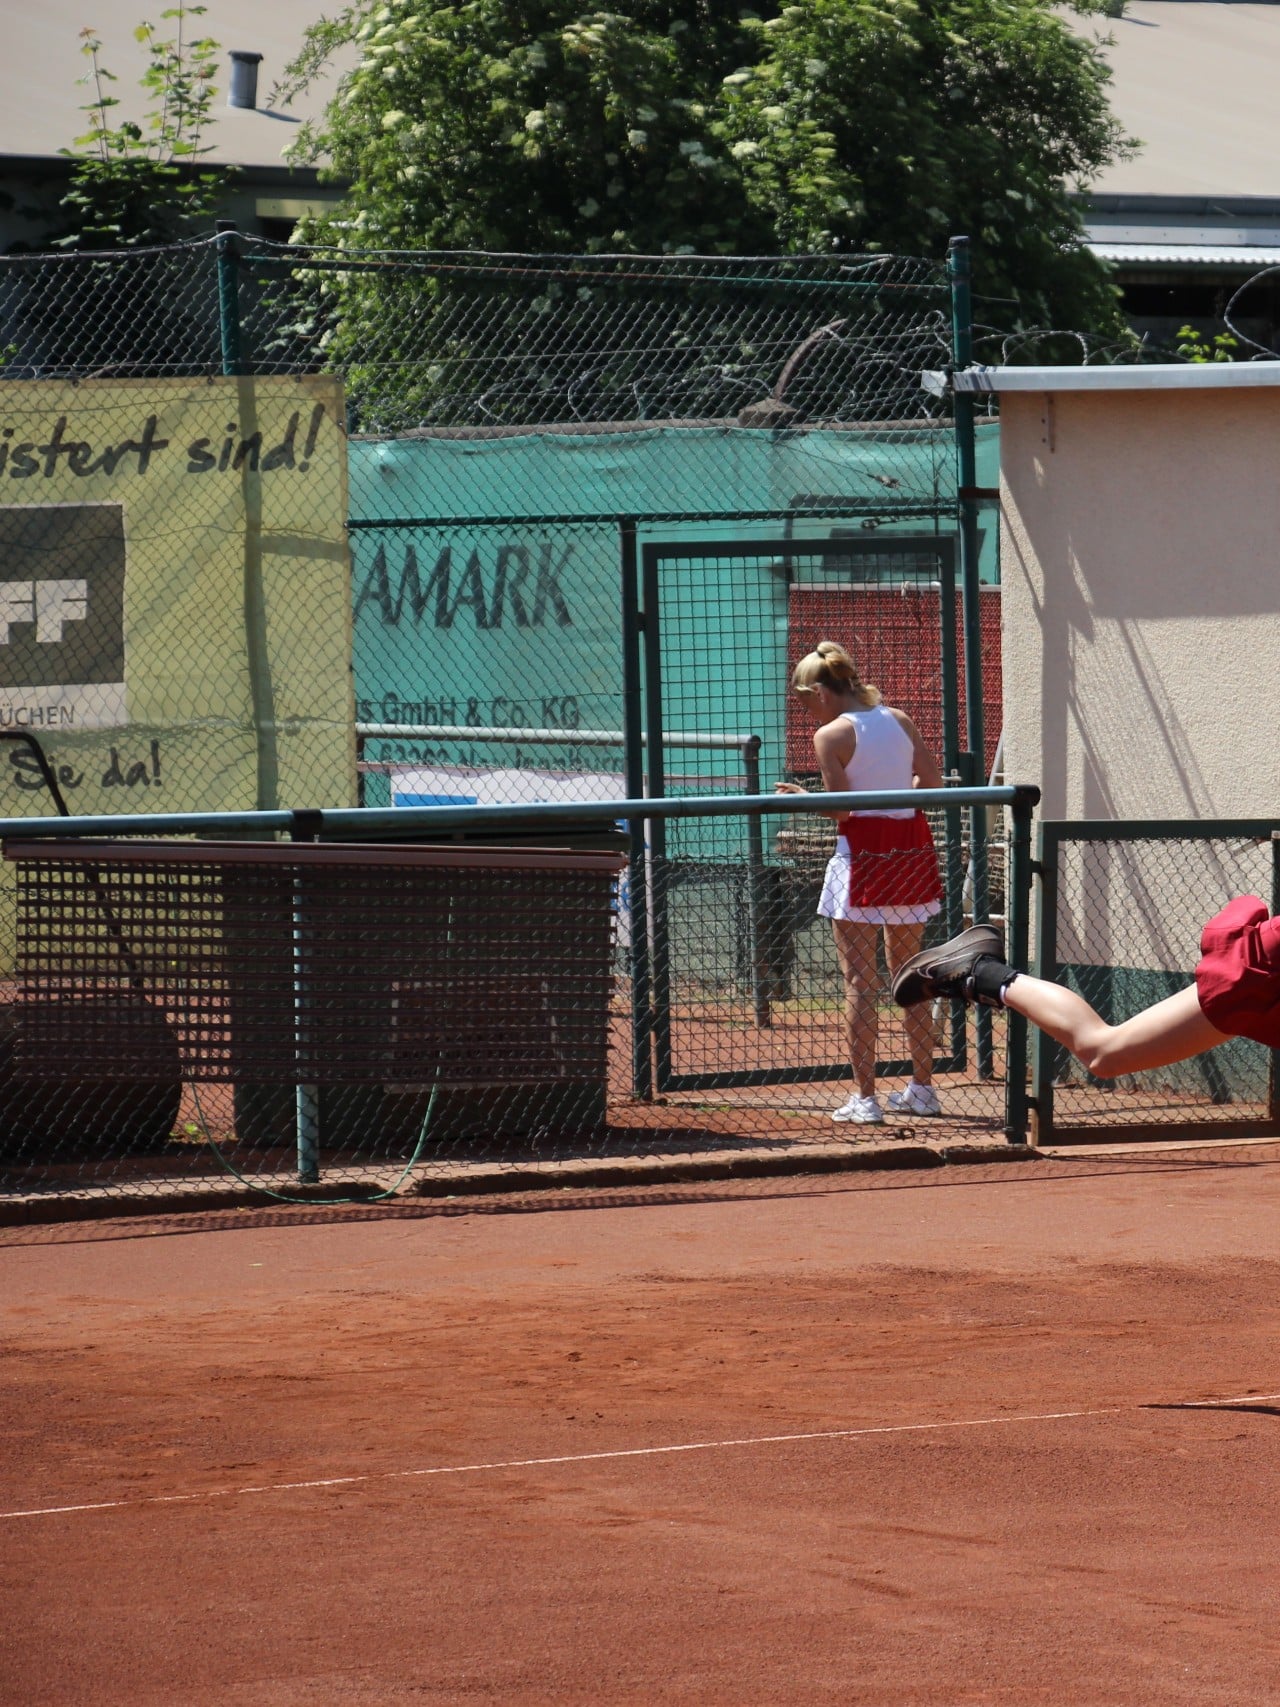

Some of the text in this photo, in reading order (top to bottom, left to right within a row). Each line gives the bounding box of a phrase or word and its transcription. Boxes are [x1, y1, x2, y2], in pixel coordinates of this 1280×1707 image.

[0, 403, 325, 478] istert sind!
[350, 542, 575, 629] AMARK
[382, 692, 455, 725] GmbH
[466, 697, 481, 726] &
[542, 696, 579, 730] KG
[9, 739, 162, 790] Sie da!
